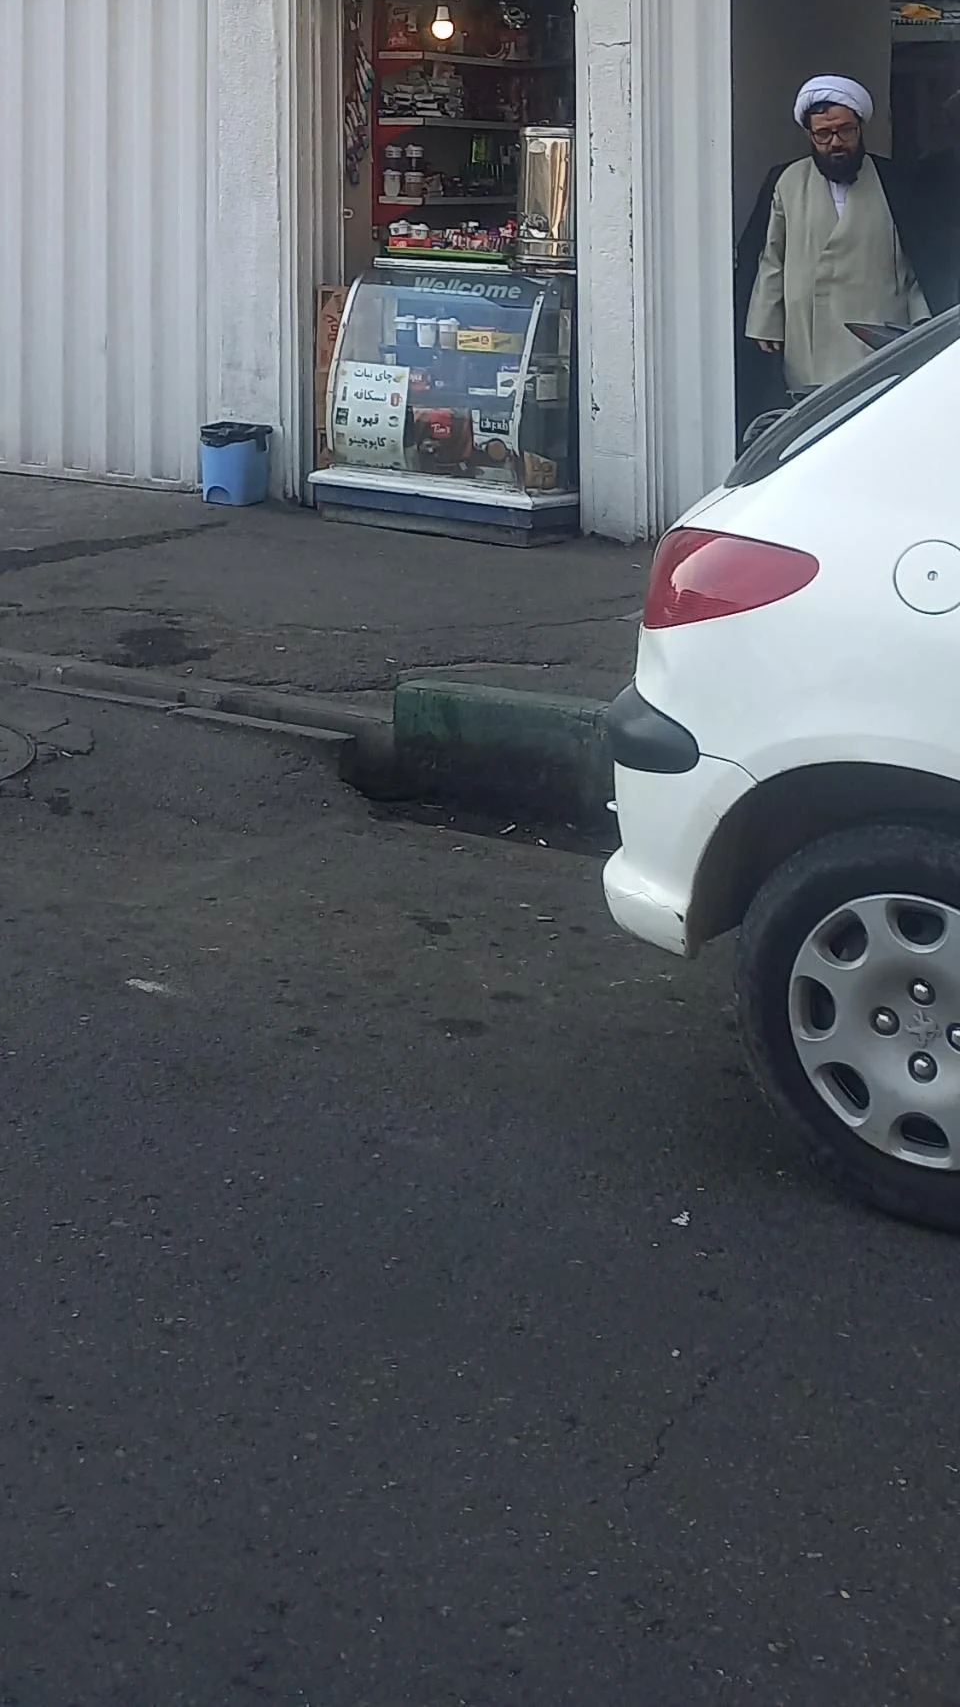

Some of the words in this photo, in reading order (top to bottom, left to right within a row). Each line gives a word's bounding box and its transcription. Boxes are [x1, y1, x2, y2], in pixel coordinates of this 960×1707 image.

[414, 276, 522, 299] Wellcome
[353, 368, 372, 380] نبات
[375, 370, 392, 383] چای
[354, 388, 387, 402] نسکافه
[356, 413, 380, 427] قهوه
